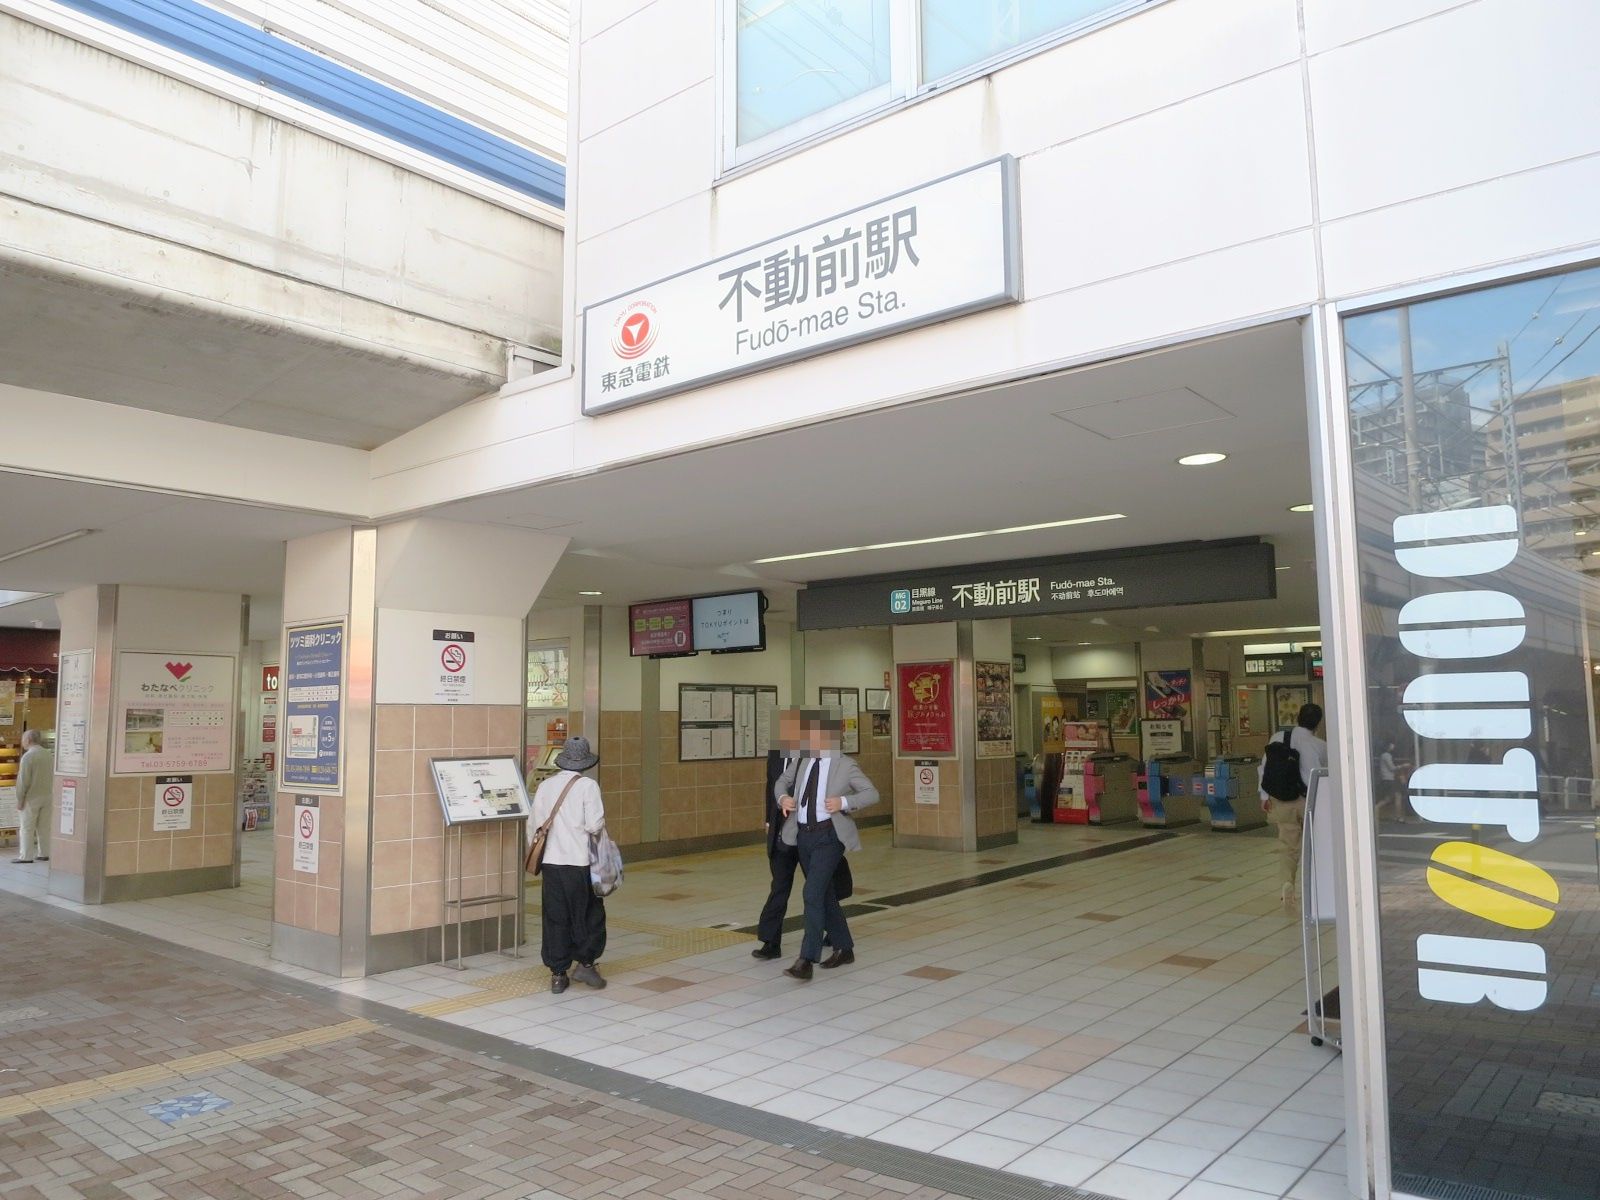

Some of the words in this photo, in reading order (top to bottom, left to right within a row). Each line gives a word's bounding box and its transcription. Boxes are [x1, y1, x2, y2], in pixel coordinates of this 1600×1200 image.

[718, 206, 920, 323] 不動前駅
[736, 304, 849, 355] Fudō-mae
[858, 288, 907, 319] Sta.
[601, 355, 670, 393] 東急電鉄
[1097, 576, 1116, 586] Sta.
[895, 592, 906, 600] MG
[911, 586, 936, 599] 目黒線
[952, 578, 1041, 608] 不動前駅
[894, 600, 907, 610] 02
[444, 632, 464, 640] お願い
[141, 683, 214, 693] わたなべクリニック
[1393, 505, 1560, 1011] DOUTOR
